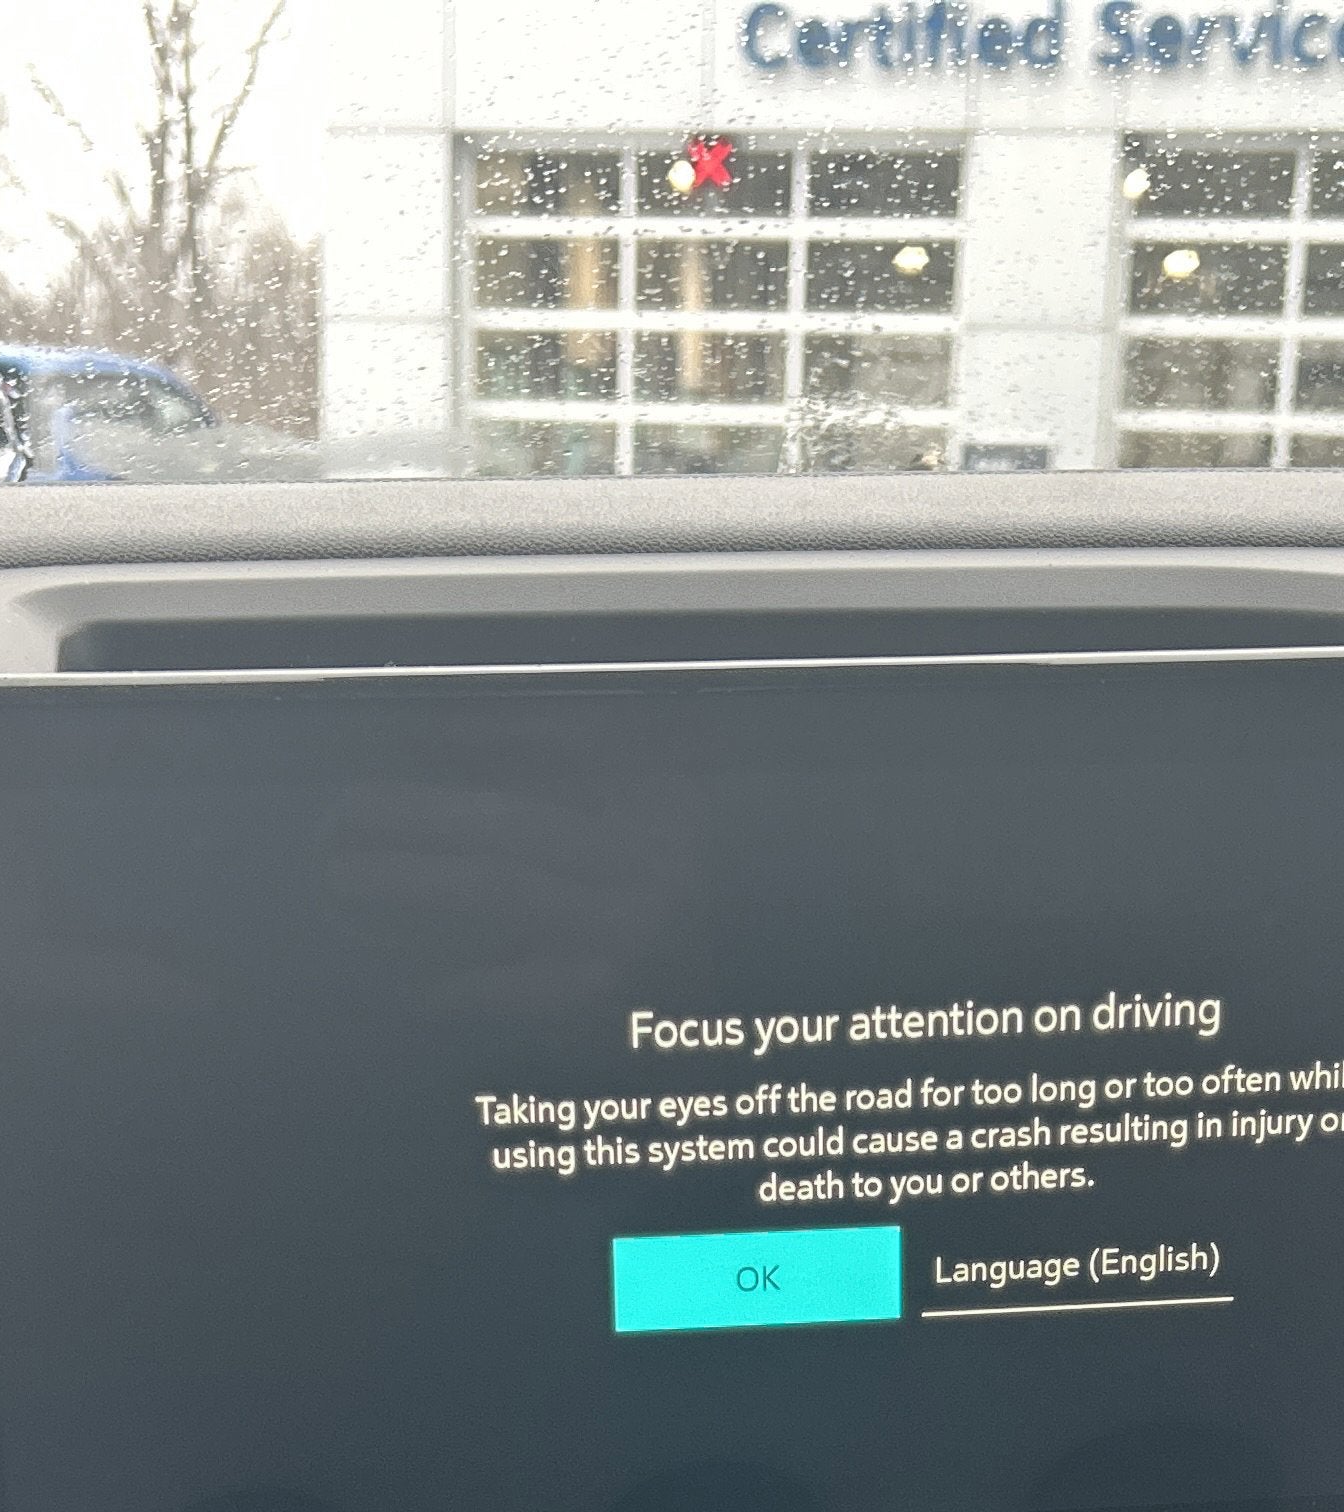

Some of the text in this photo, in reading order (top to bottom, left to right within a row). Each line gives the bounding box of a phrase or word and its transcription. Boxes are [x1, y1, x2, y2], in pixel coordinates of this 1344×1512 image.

[739, 0, 1064, 70] Certified
[630, 990, 1221, 1057] Focus your attention on driving
[474, 1092, 576, 1132] Taking
[583, 1097, 653, 1131] your
[657, 1094, 729, 1127] eyes
[735, 1082, 783, 1116] off
[786, 1081, 837, 1114] the
[845, 1077, 913, 1111] road
[919, 1076, 966, 1108] for
[970, 1078, 1023, 1106] too
[1031, 1072, 1097, 1109] long
[1104, 1077, 1138, 1099] or
[1142, 1071, 1194, 1098] too
[1201, 1063, 1281, 1095] often
[491, 1139, 576, 1176] using
[582, 1134, 641, 1167] this
[647, 1134, 755, 1172] system
[762, 1124, 844, 1159] could
[852, 1130, 939, 1155] cause
[945, 1129, 964, 1151] a
[970, 1116, 1051, 1149] crash
[1059, 1112, 1188, 1149] resulting
[1197, 1111, 1223, 1139] in
[1231, 1108, 1314, 1145] injury
[757, 1160, 1095, 1205] death to you or others.
[735, 1265, 780, 1292] OK
[935, 1241, 1220, 1289] Language (English)
